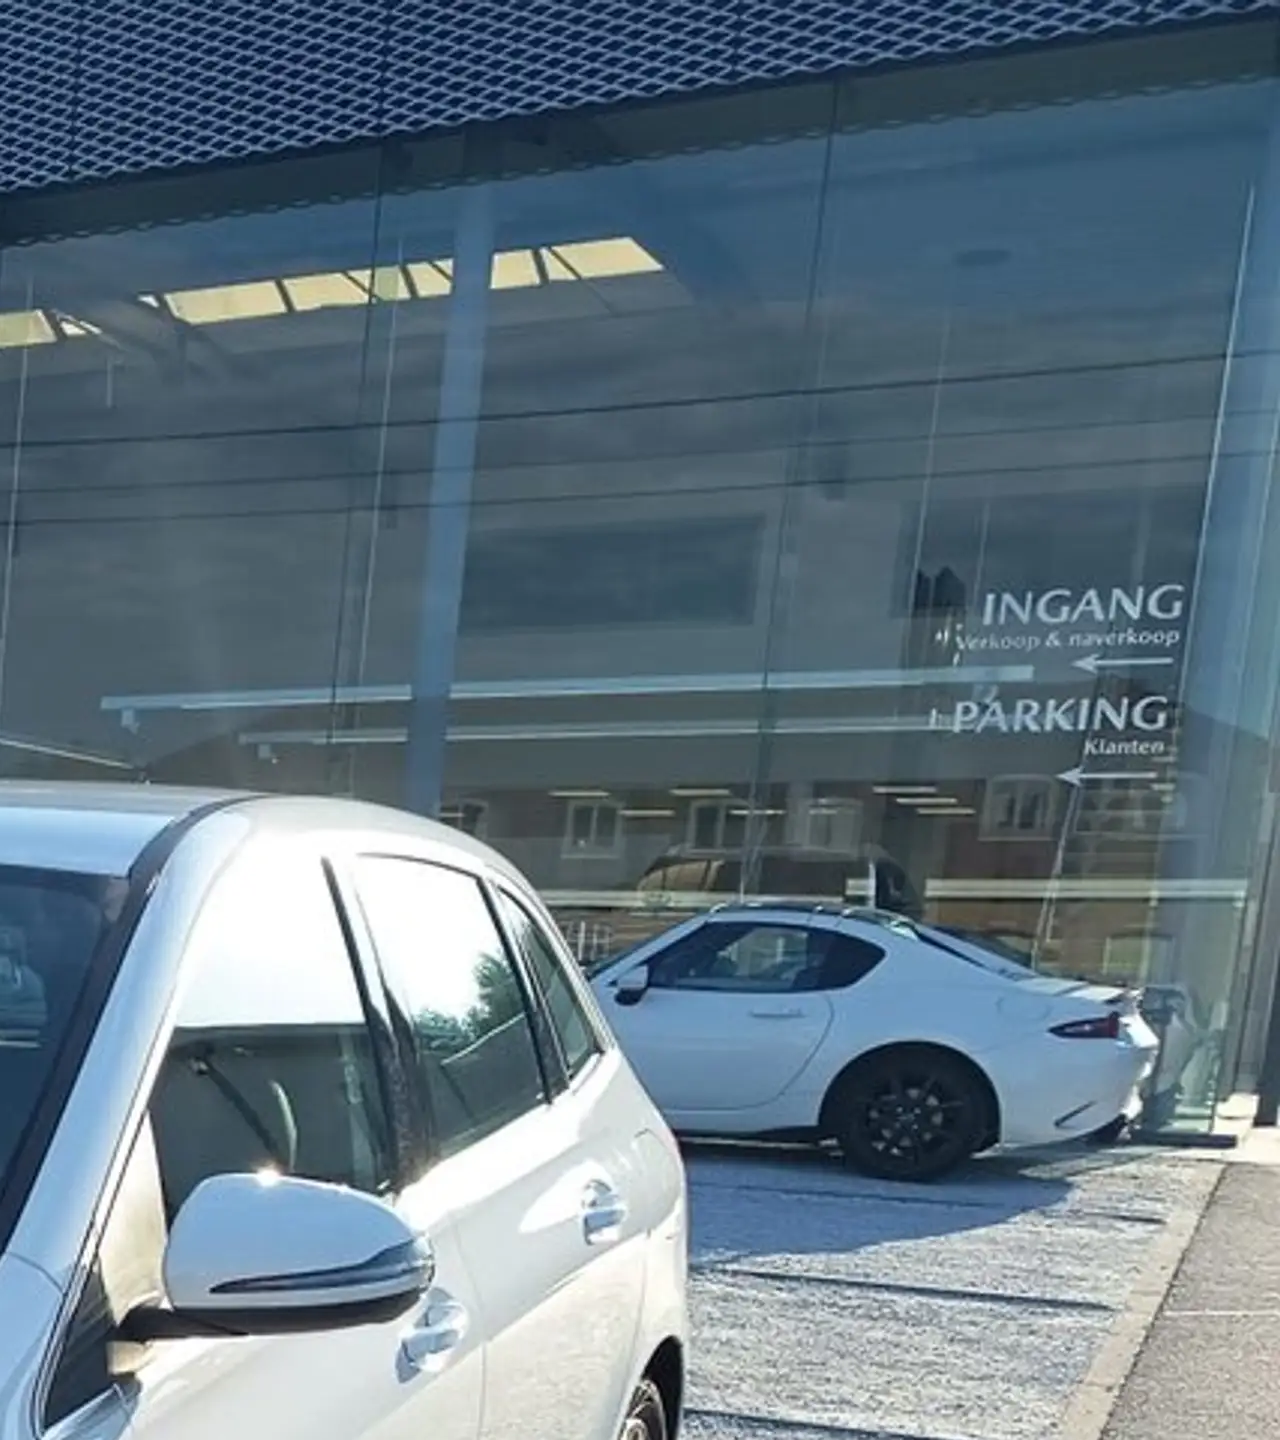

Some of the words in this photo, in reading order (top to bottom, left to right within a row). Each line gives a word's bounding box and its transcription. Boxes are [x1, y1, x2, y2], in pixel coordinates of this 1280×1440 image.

[982, 584, 1185, 626] INGANG
[1045, 630, 1061, 647] &
[1069, 627, 1180, 647] naverkoop
[953, 696, 1168, 733] PARKING
[1084, 738, 1164, 755] Klanten
